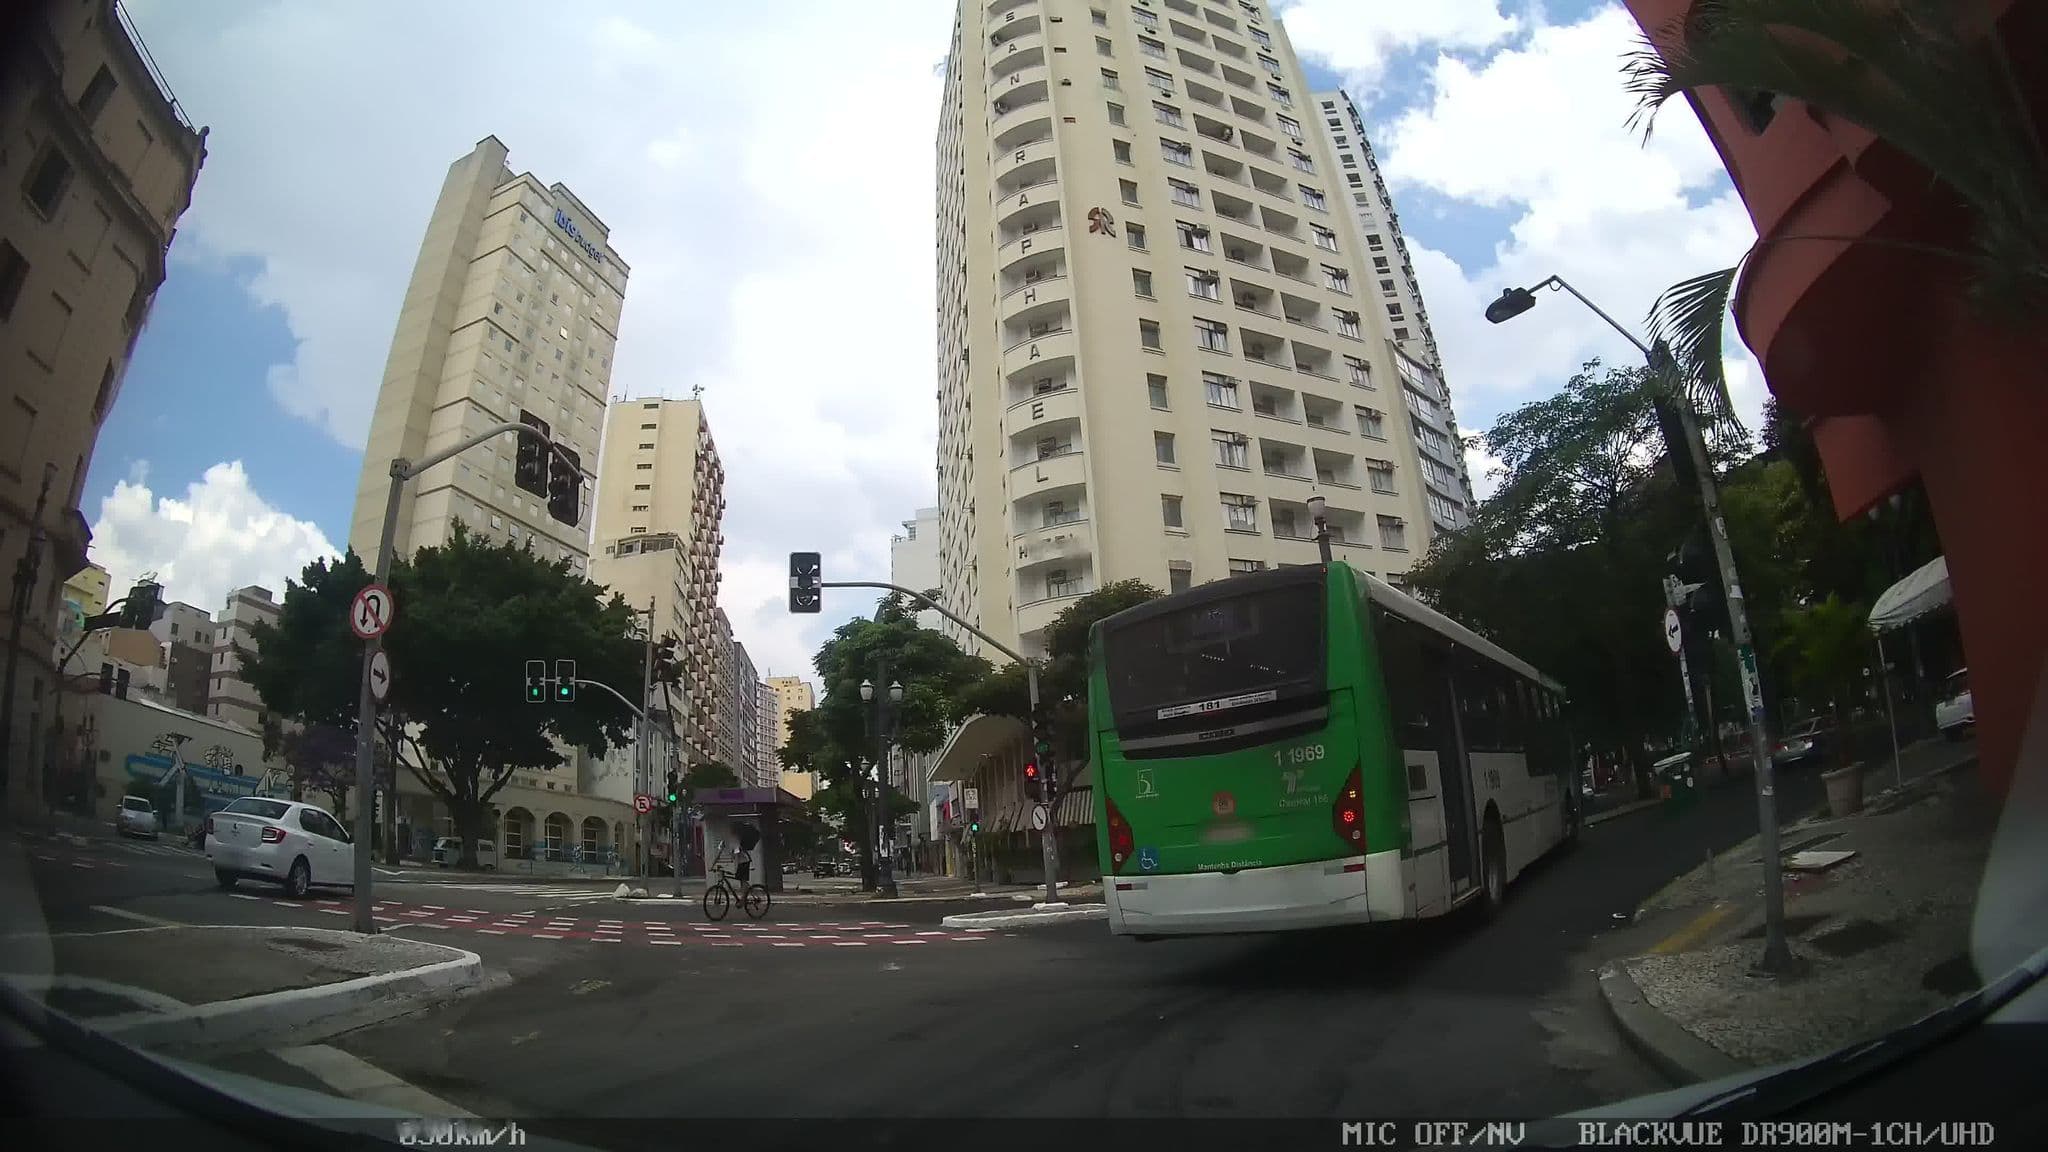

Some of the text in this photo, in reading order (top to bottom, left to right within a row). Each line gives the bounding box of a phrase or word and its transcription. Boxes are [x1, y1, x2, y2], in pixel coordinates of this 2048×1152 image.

[554, 207, 576, 238] ibis
[1005, 11, 1049, 482] SAN RAPHAEL
[1199, 701, 1220, 711] 181
[1274, 745, 1325, 766] 1 1969
